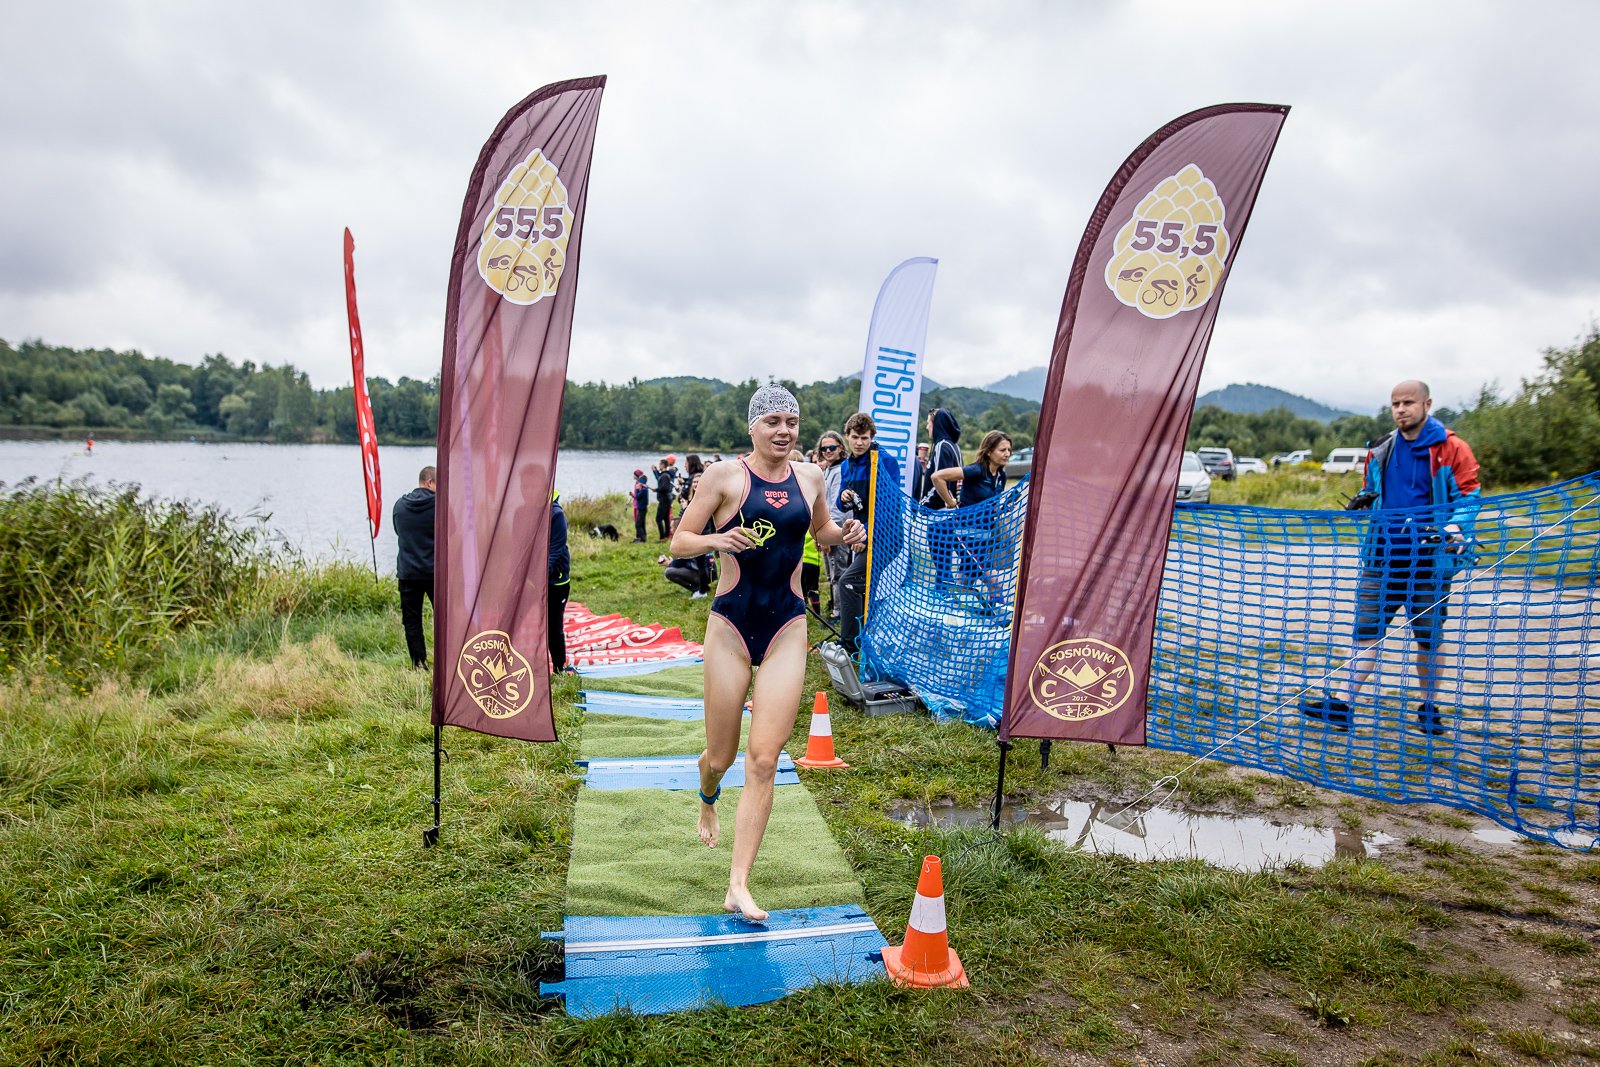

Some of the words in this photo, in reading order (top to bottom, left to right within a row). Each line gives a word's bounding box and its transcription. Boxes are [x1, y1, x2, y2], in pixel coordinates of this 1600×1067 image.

[494, 207, 564, 244] 55,5
[1130, 220, 1218, 259] 55,5
[764, 490, 788, 498] arena
[1049, 644, 1116, 665] SOSNÓWKA
[471, 668, 484, 688] C
[505, 682, 520, 701] S
[1040, 679, 1057, 698] C
[1101, 679, 1117, 699] S
